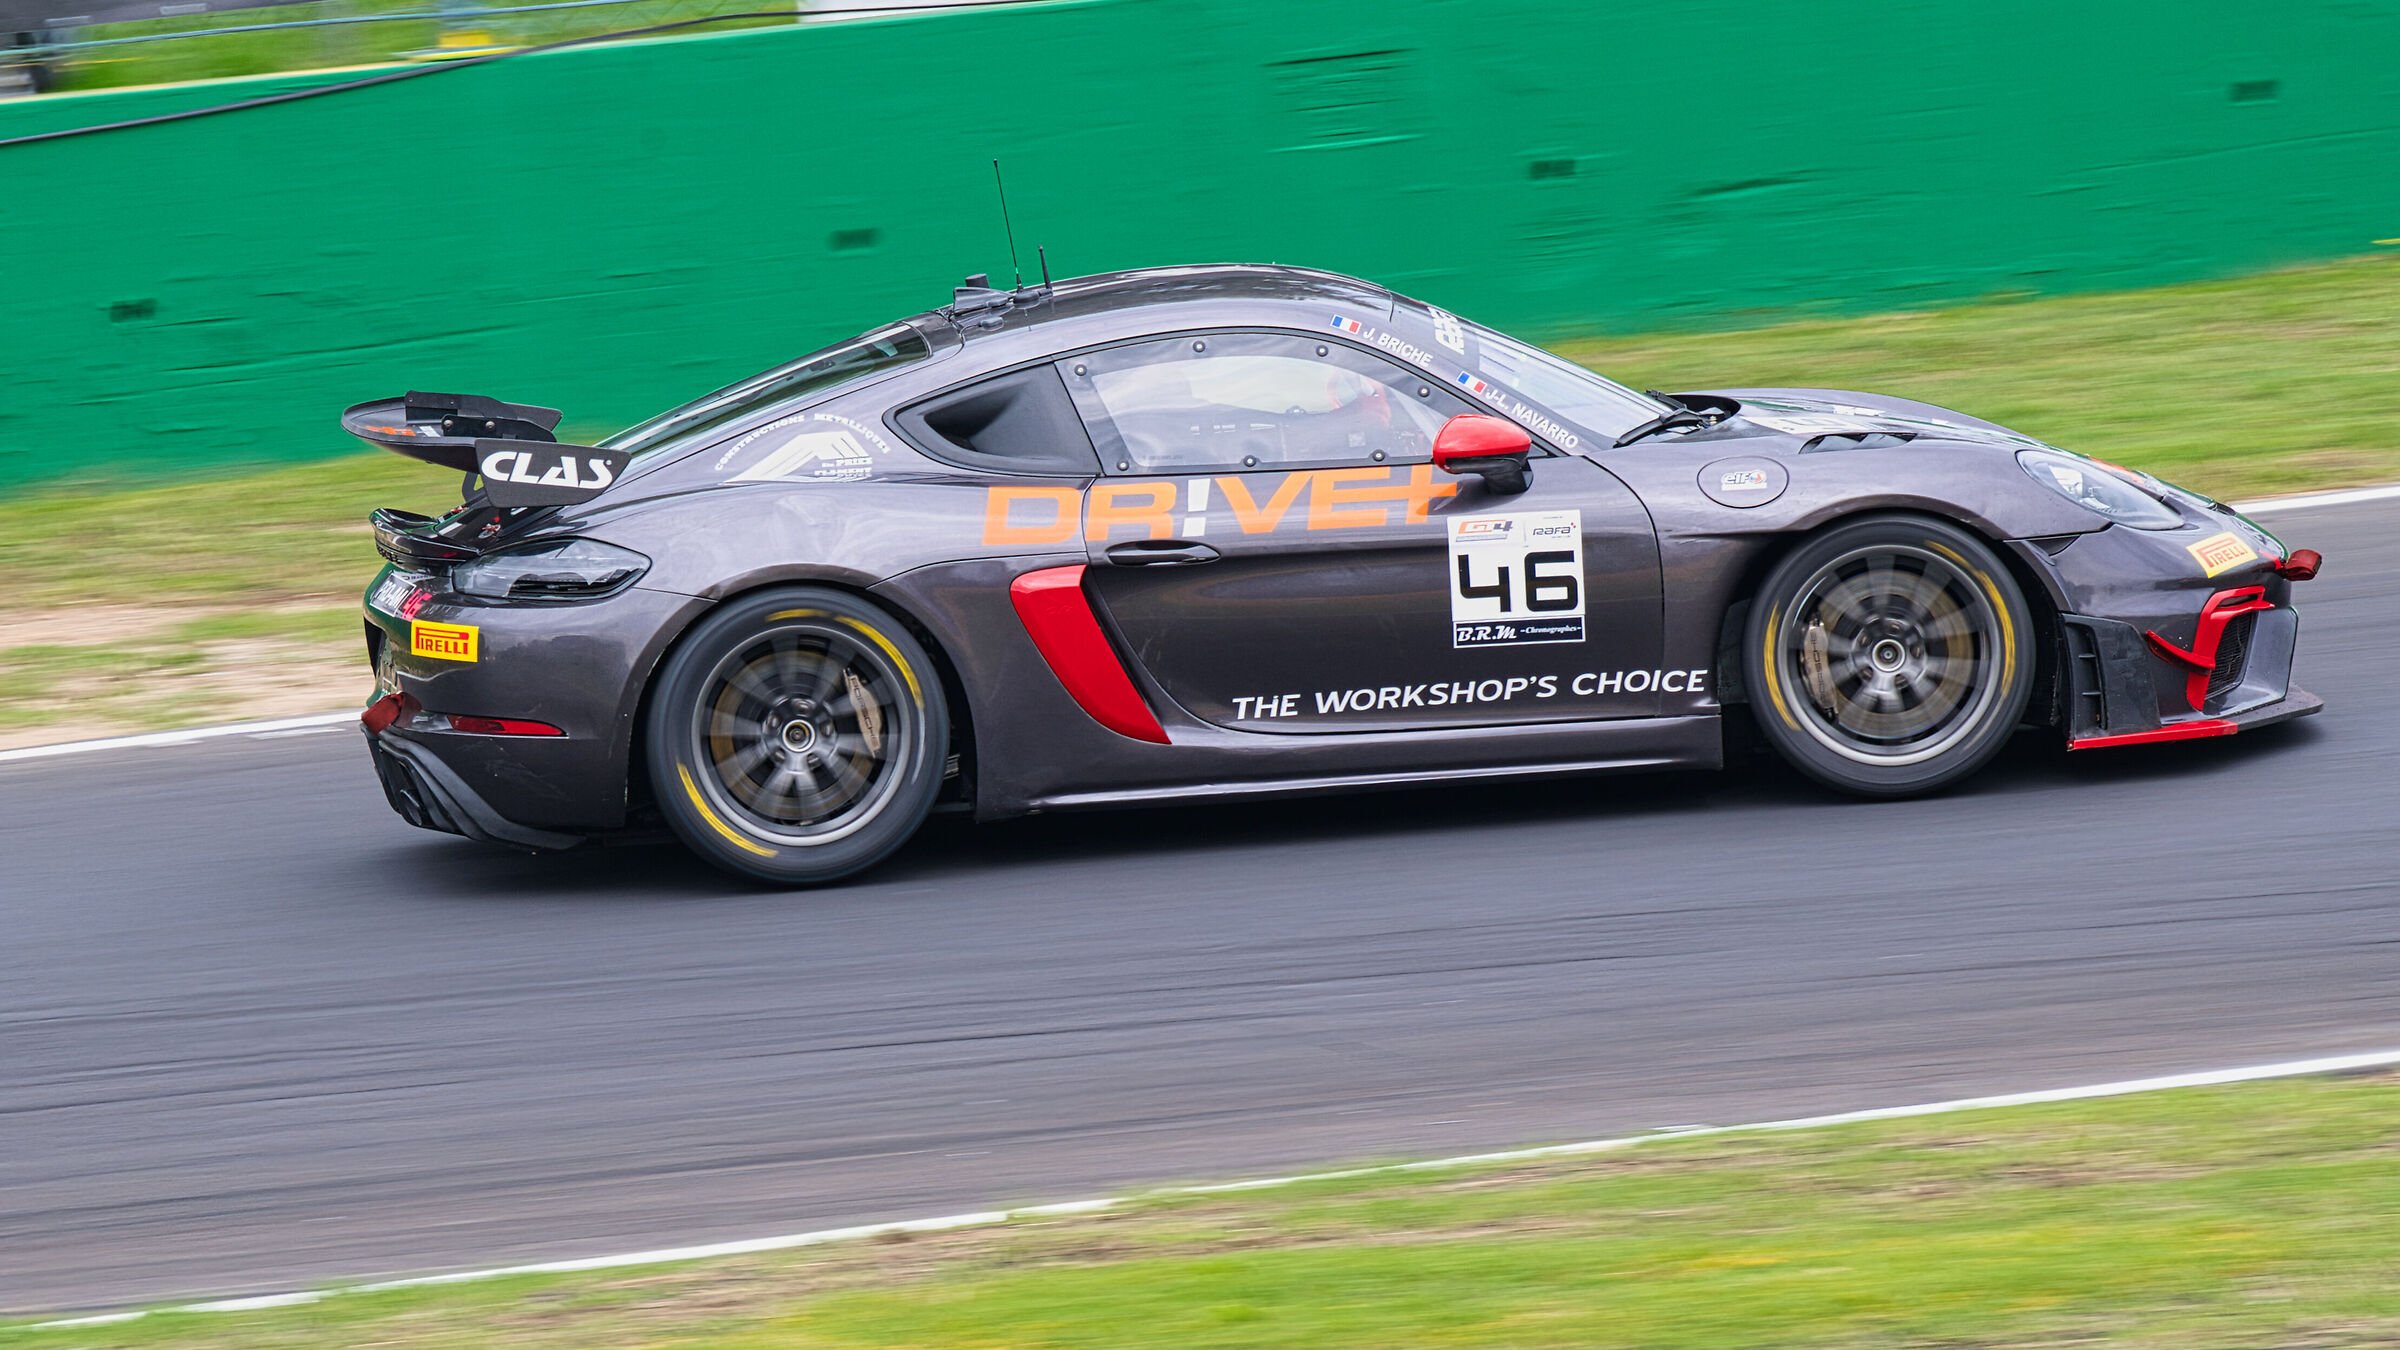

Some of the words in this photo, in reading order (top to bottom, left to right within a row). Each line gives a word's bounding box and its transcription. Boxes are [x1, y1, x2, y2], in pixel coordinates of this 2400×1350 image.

[1362, 327, 1374, 341] J.
[1377, 332, 1434, 367] BRICHE
[1485, 387, 1508, 410] J-L.
[1511, 402, 1579, 450] NAVARRO
[481, 451, 614, 490] CLAS
[2196, 538, 2249, 568] PIRELLI
[1457, 550, 1579, 612] 46
[415, 626, 470, 655] PIRELLI
[1456, 625, 1517, 642] B.R.M
[851, 677, 880, 747] PORSCHE
[1233, 694, 1301, 720] THE
[1315, 675, 1557, 715] WORKSHOP'S
[1572, 669, 1708, 695] CHOICE
